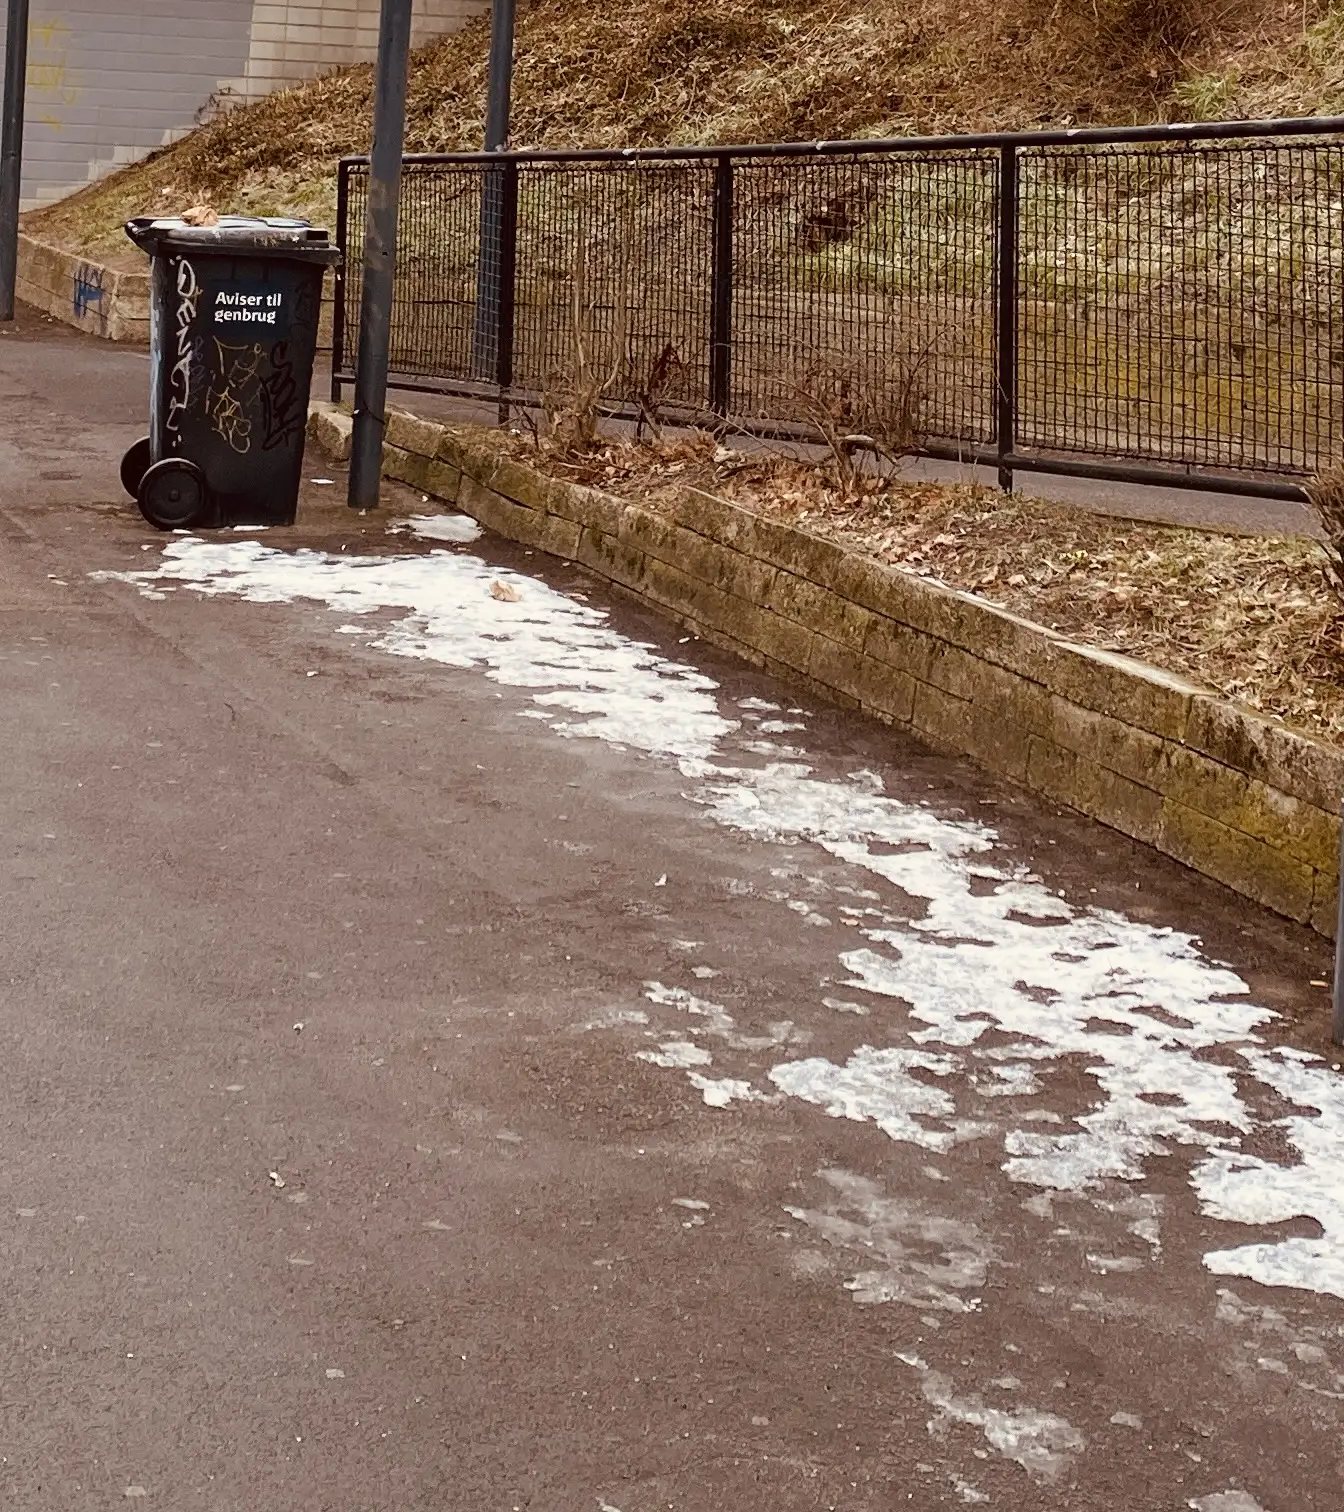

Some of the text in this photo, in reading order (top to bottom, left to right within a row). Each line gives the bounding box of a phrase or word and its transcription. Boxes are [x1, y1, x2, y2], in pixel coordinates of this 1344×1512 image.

[214, 291, 282, 307] Aviser til
[214, 307, 276, 325] genbrug
